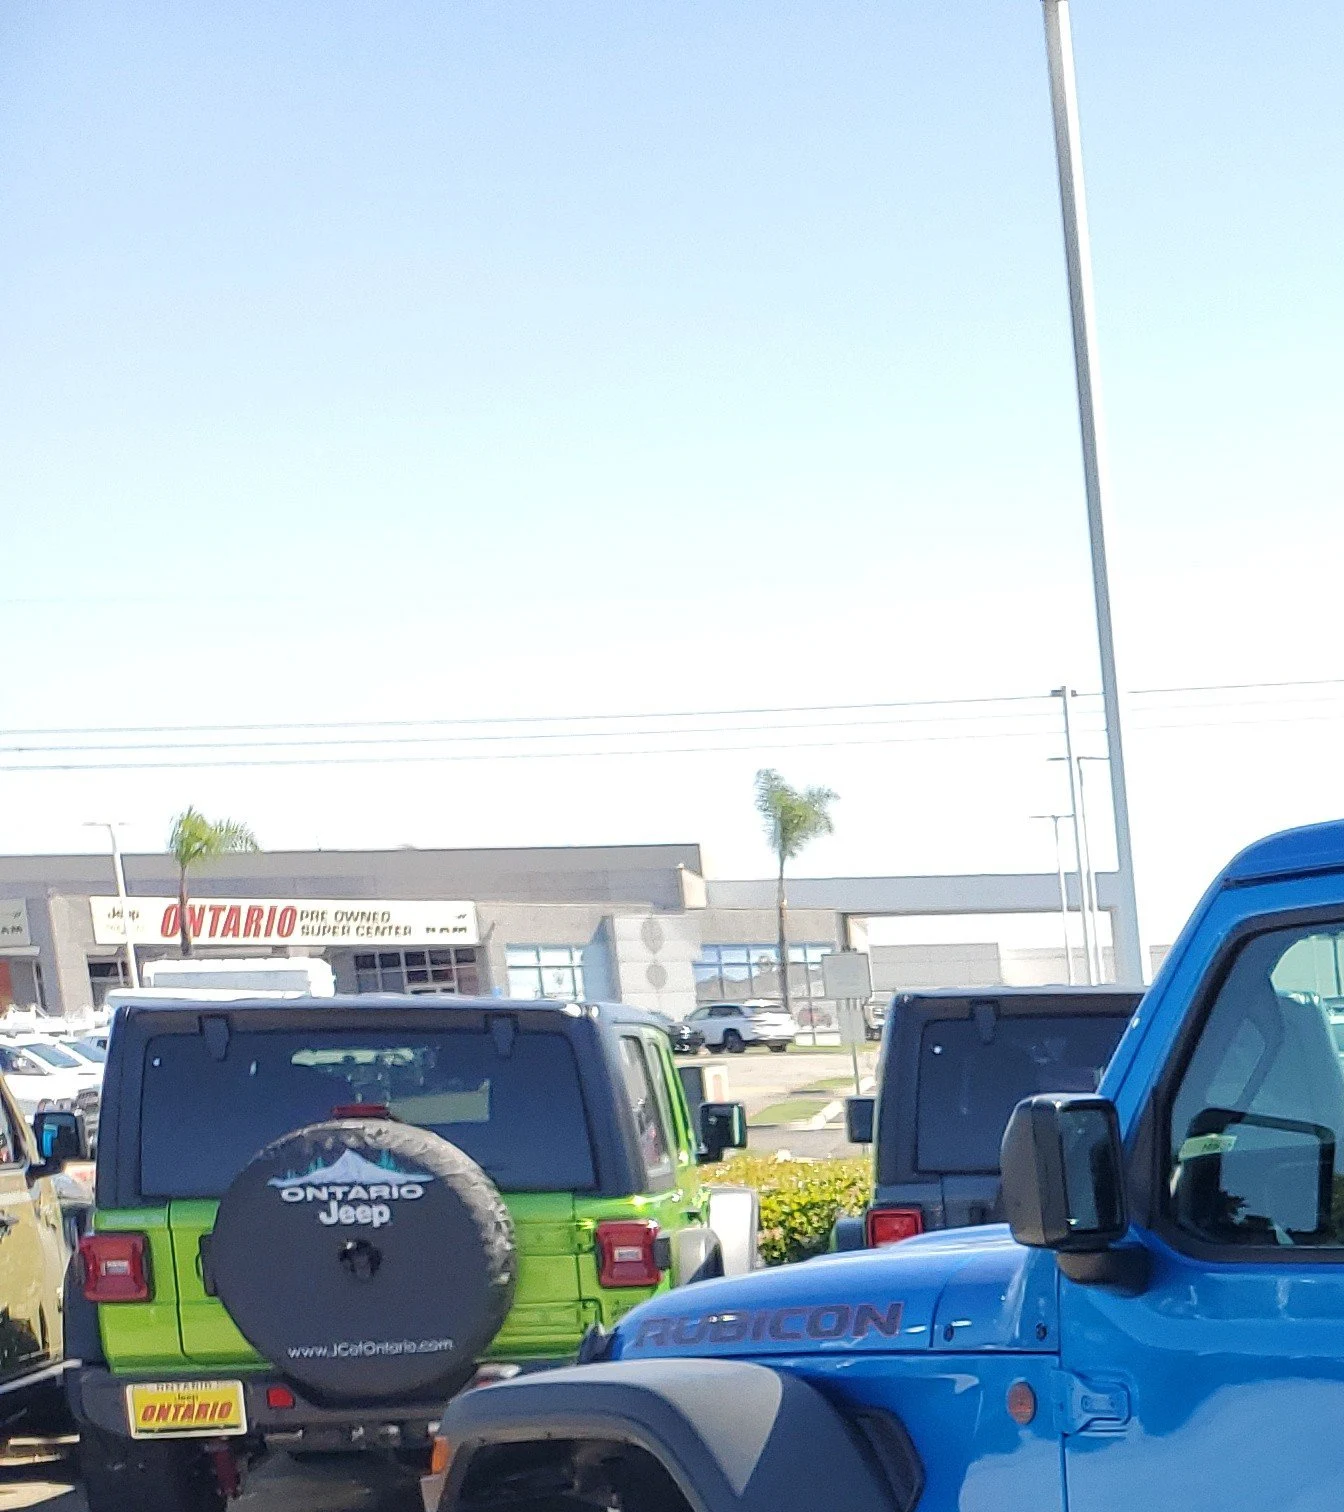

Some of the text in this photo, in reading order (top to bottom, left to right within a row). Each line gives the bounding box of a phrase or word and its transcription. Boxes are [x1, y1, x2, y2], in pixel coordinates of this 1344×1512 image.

[107, 905, 140, 923] Jep
[160, 904, 298, 938] ONTARIO
[300, 909, 391, 924] PRE OWNED
[300, 924, 412, 938] SUPER CENTER
[281, 1183, 425, 1203] ONTARIO
[318, 1200, 391, 1229] Jeep
[633, 1301, 904, 1350] RUBICON
[141, 1401, 233, 1421] ONTARIO
